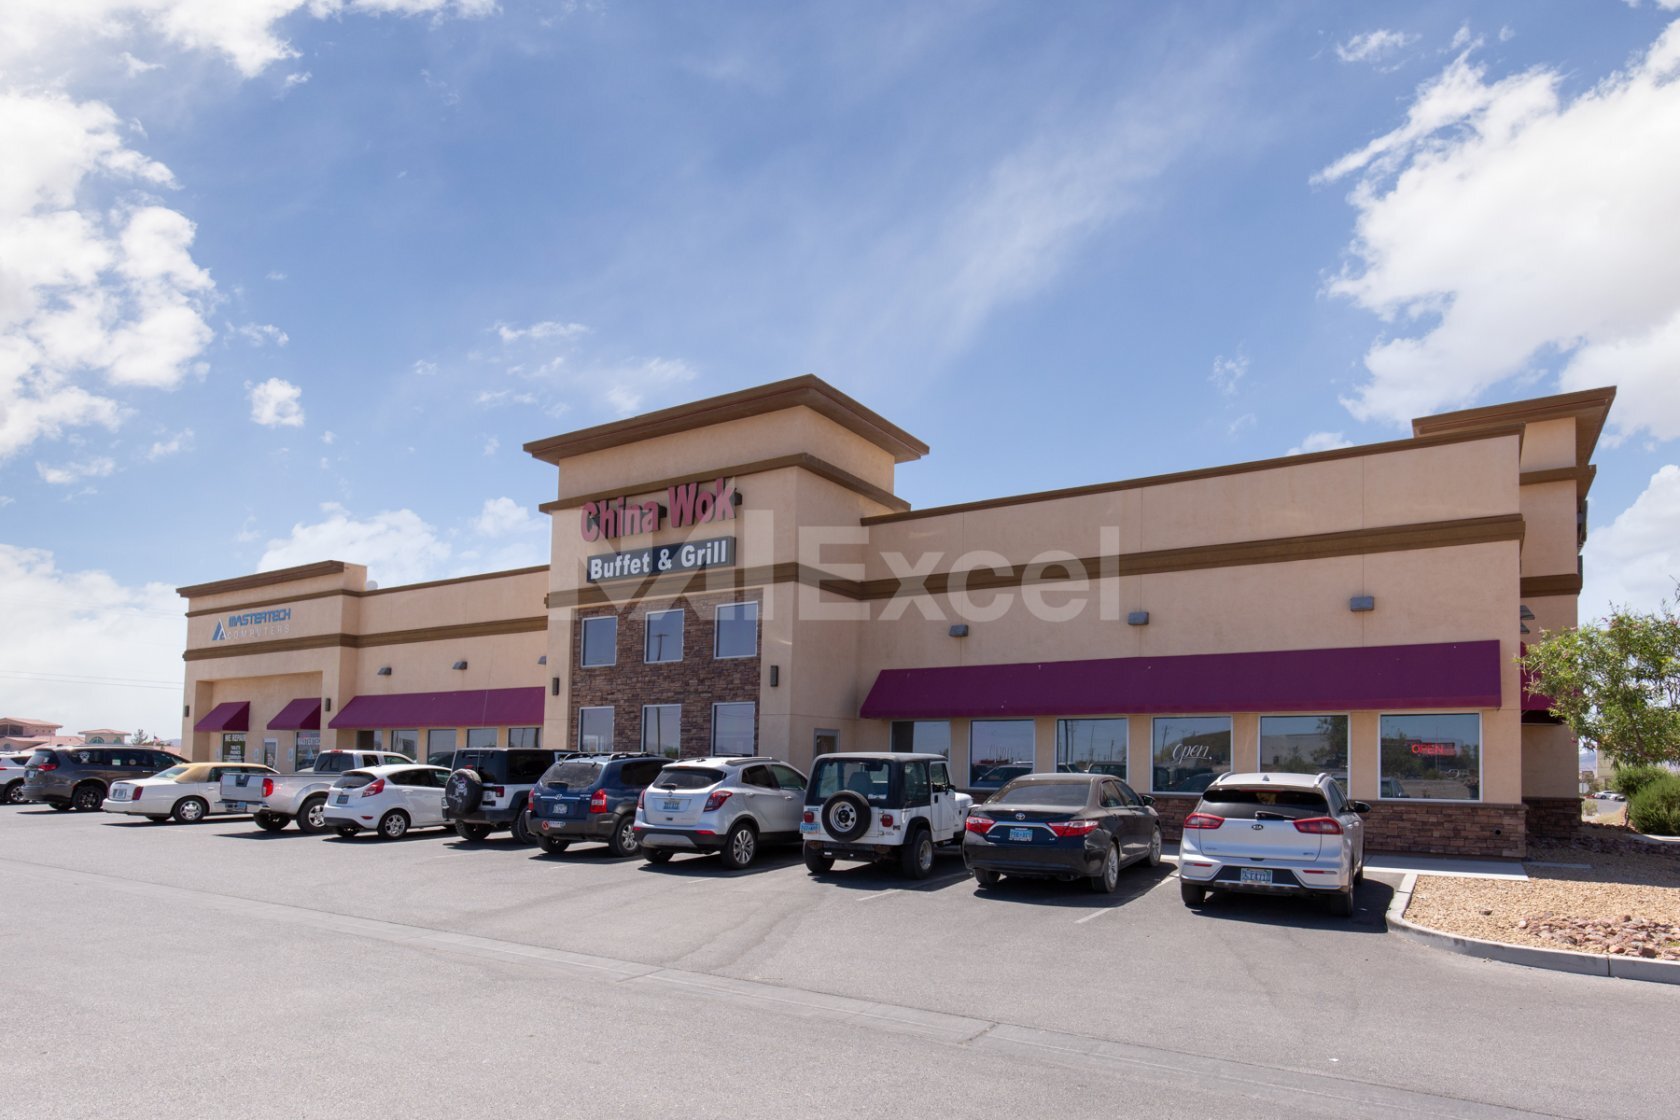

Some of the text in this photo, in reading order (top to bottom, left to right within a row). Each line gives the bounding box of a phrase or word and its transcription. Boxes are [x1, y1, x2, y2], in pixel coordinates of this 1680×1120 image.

[581, 496, 660, 542] China
[590, 539, 727, 580] Buffet & Grill
[1172, 743, 1209, 765] Open
[1411, 743, 1443, 756] OPEN
